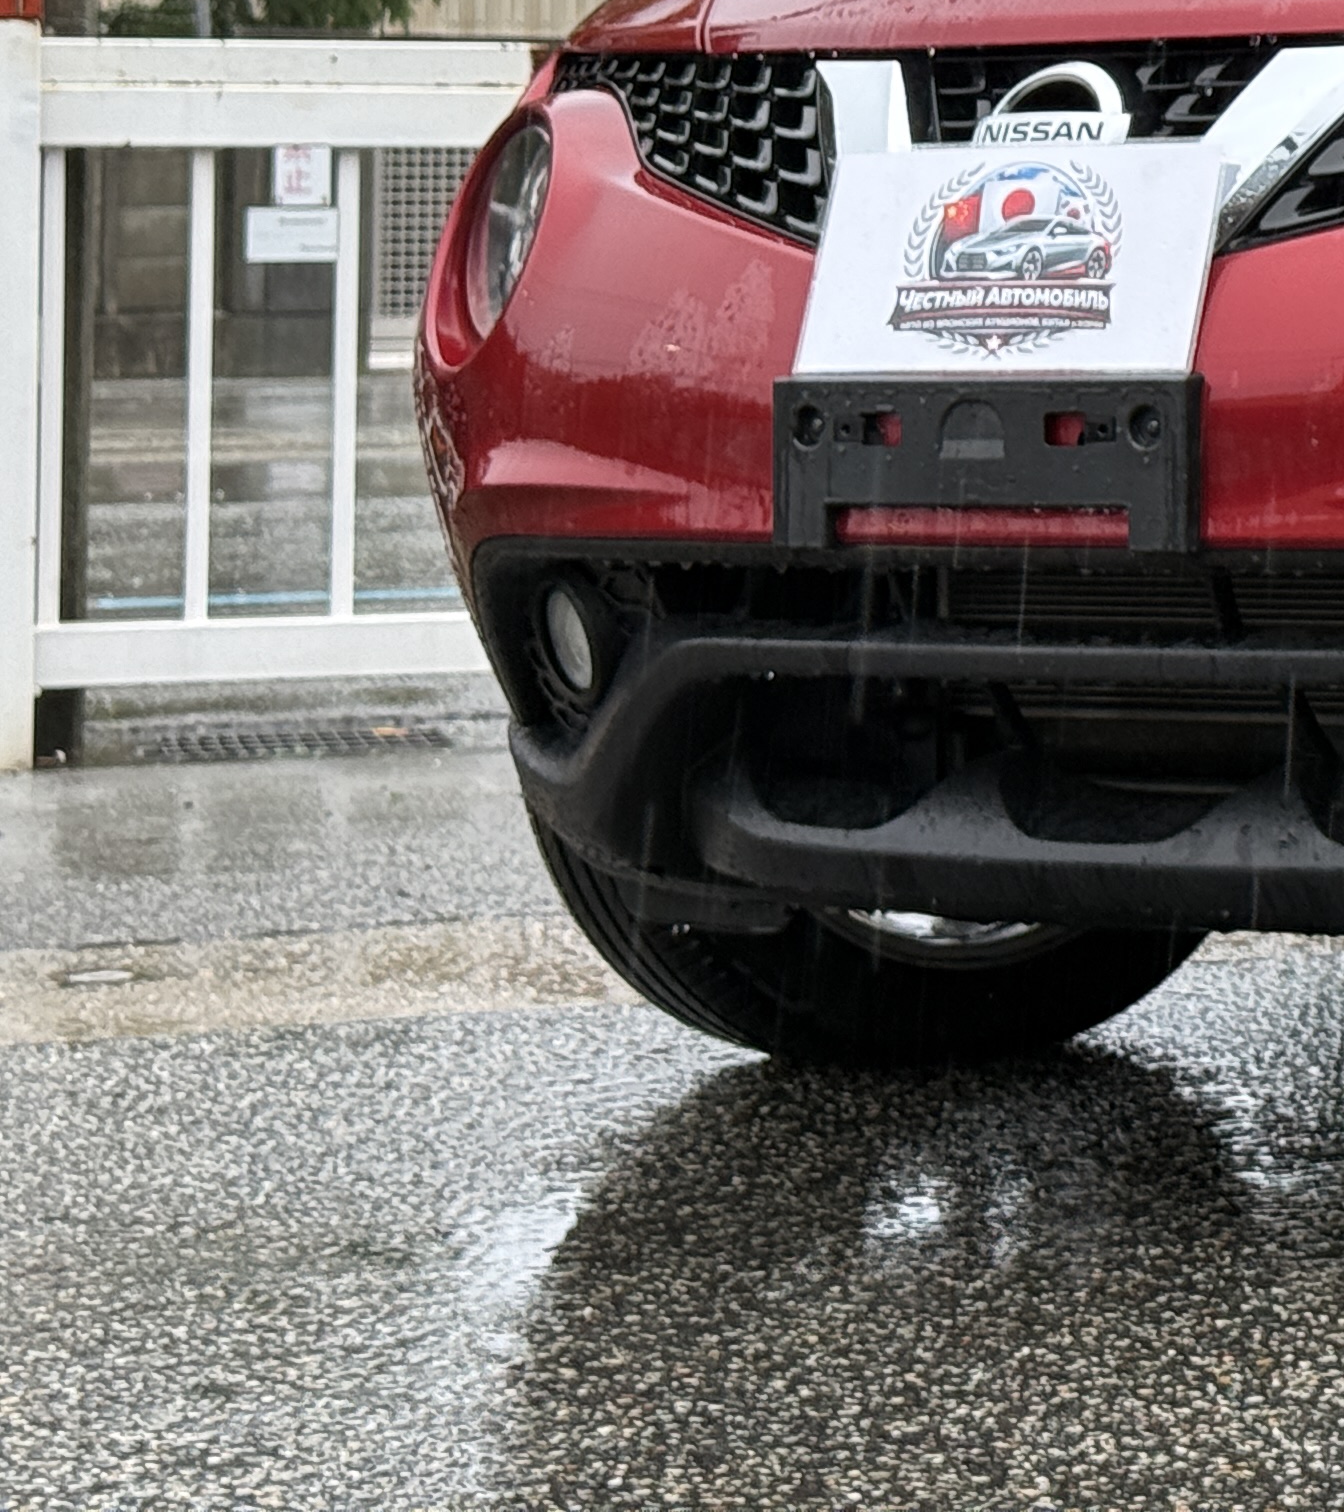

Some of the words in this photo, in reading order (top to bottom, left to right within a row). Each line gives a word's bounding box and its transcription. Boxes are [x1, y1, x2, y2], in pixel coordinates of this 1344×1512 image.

[981, 121, 1105, 143] NISSAN
[899, 286, 983, 312] ЧЕСТНЫЙ
[985, 286, 1109, 311] АВТОМОБИЛЬ
